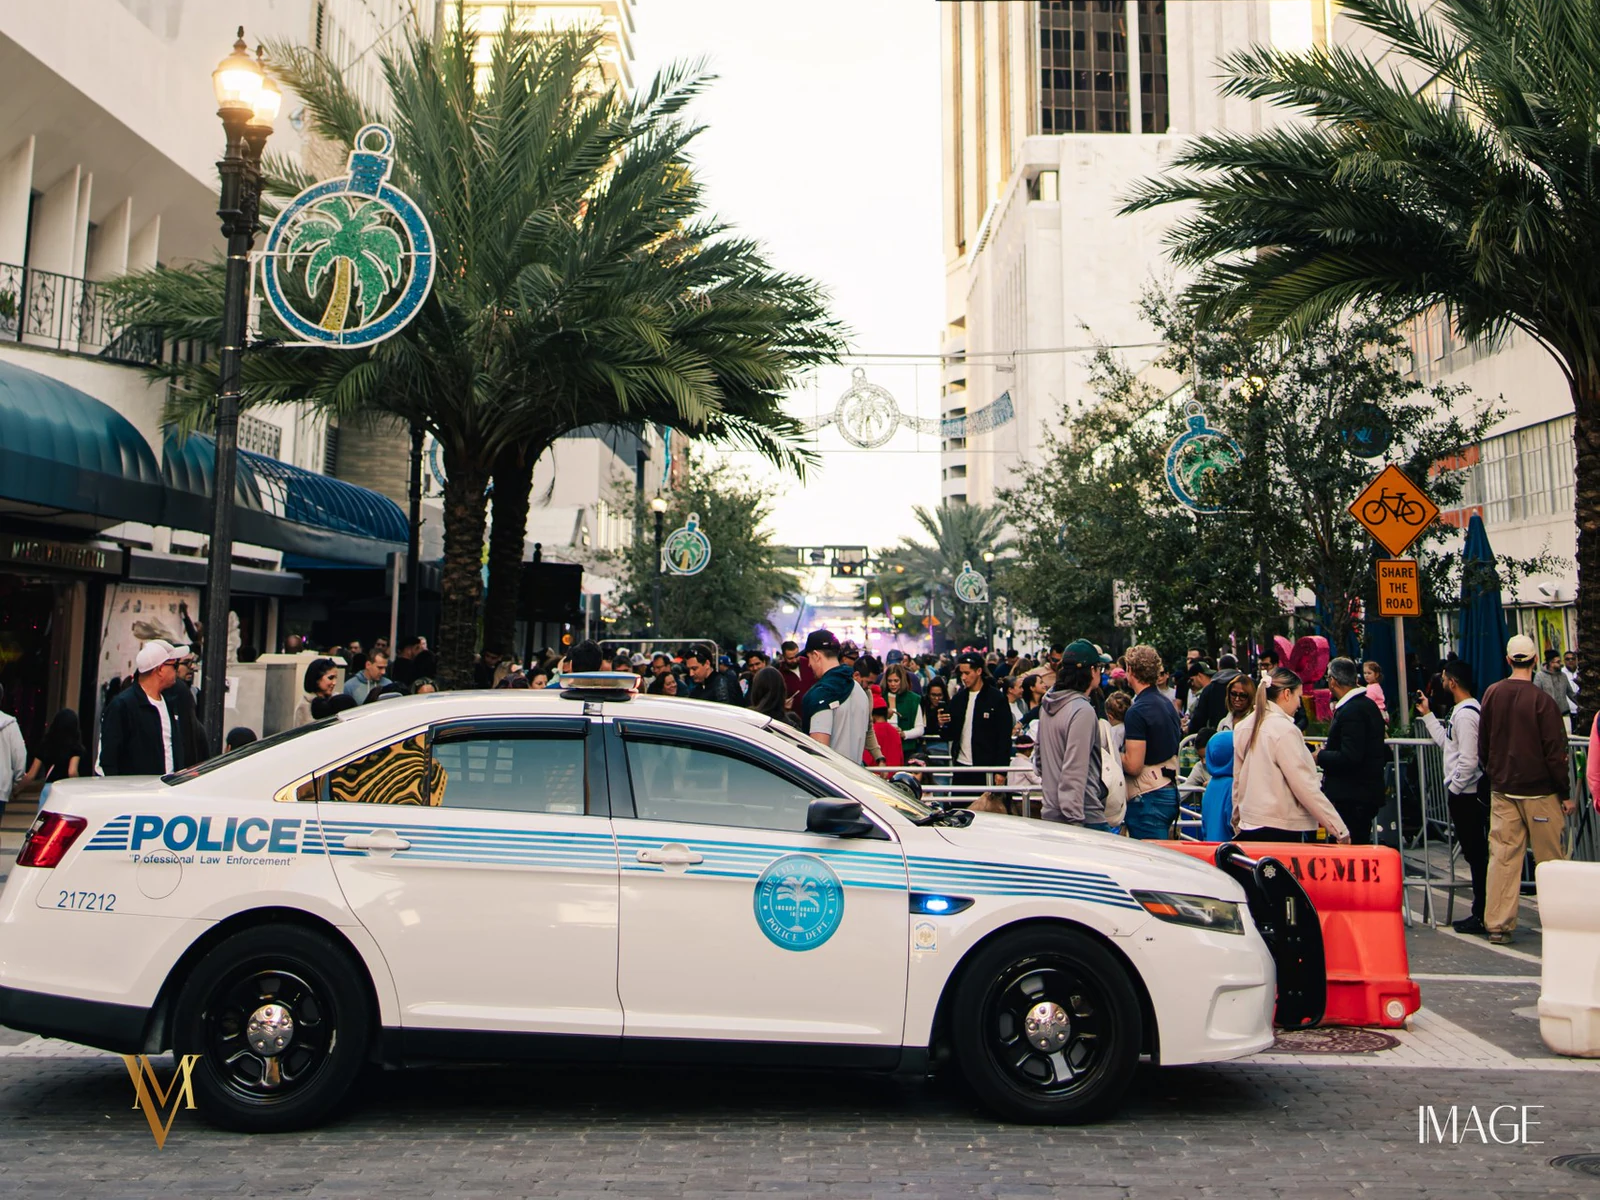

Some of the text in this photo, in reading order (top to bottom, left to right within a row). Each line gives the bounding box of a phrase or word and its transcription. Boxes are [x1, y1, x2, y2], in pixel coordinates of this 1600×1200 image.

[1381, 567, 1414, 578] SHARE
[1389, 583, 1408, 594] THE
[1386, 598, 1413, 609] ROAD
[131, 815, 302, 853] POLICE
[129, 854, 195, 865] "Pofessional
[200, 855, 221, 865] Law
[1288, 857, 1380, 883] ACME
[763, 878, 775, 897] THE
[57, 890, 117, 911] 217212
[767, 917, 797, 940] POLICE
